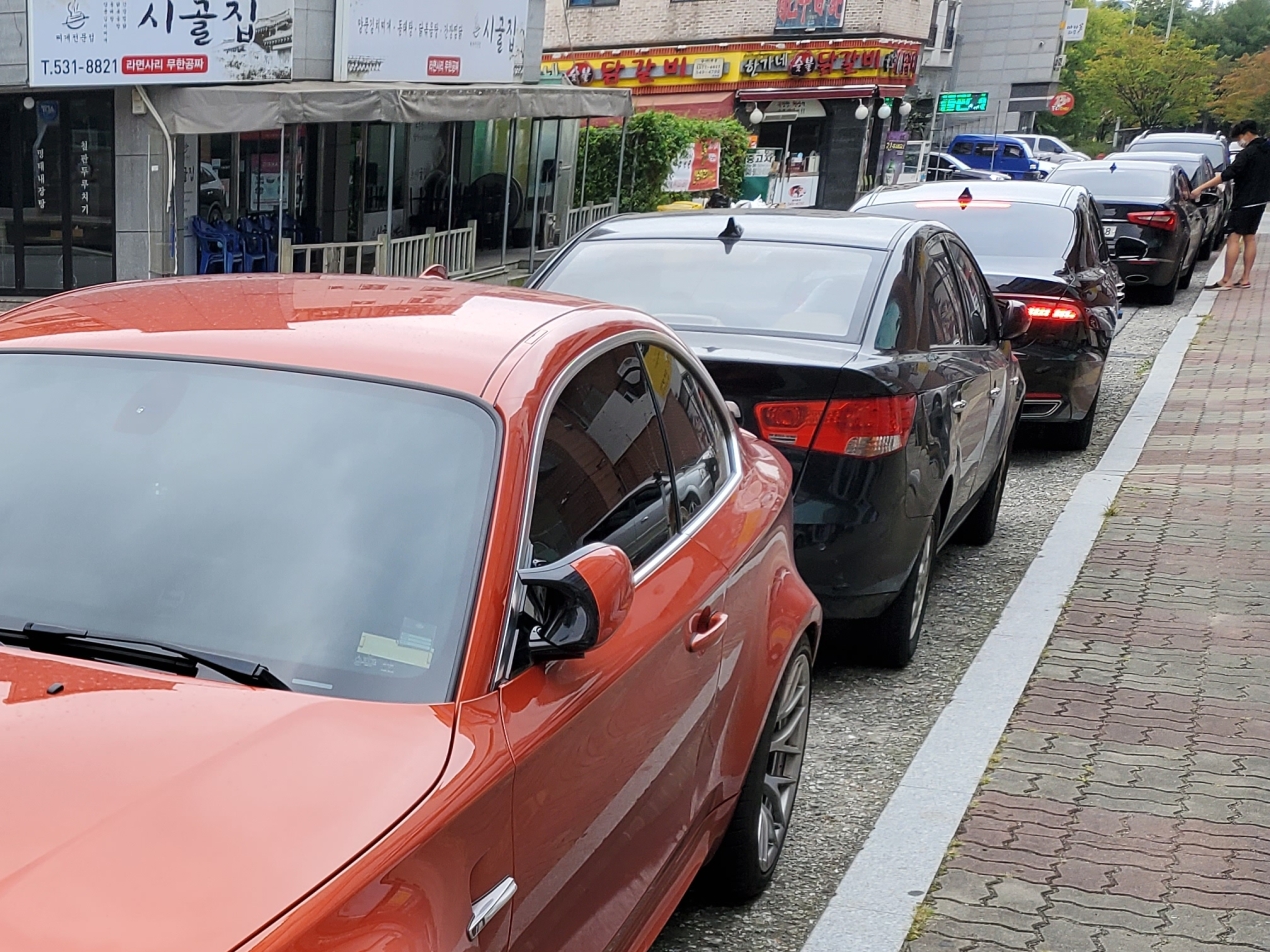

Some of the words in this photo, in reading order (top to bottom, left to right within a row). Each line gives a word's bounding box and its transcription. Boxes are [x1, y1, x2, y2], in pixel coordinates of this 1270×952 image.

[137, 0, 257, 46] 시골집
[483, 15, 517, 53] 시골집
[41, 59, 118, 76] T.531-8821
[126, 58, 164, 71] 라면사리
[166, 57, 205, 70] 무한공짜
[600, 56, 687, 86] 닭갈비
[744, 52, 788, 77] 한가네
[792, 56, 815, 72] 숯불
[817, 49, 880, 76] 닭갈비
